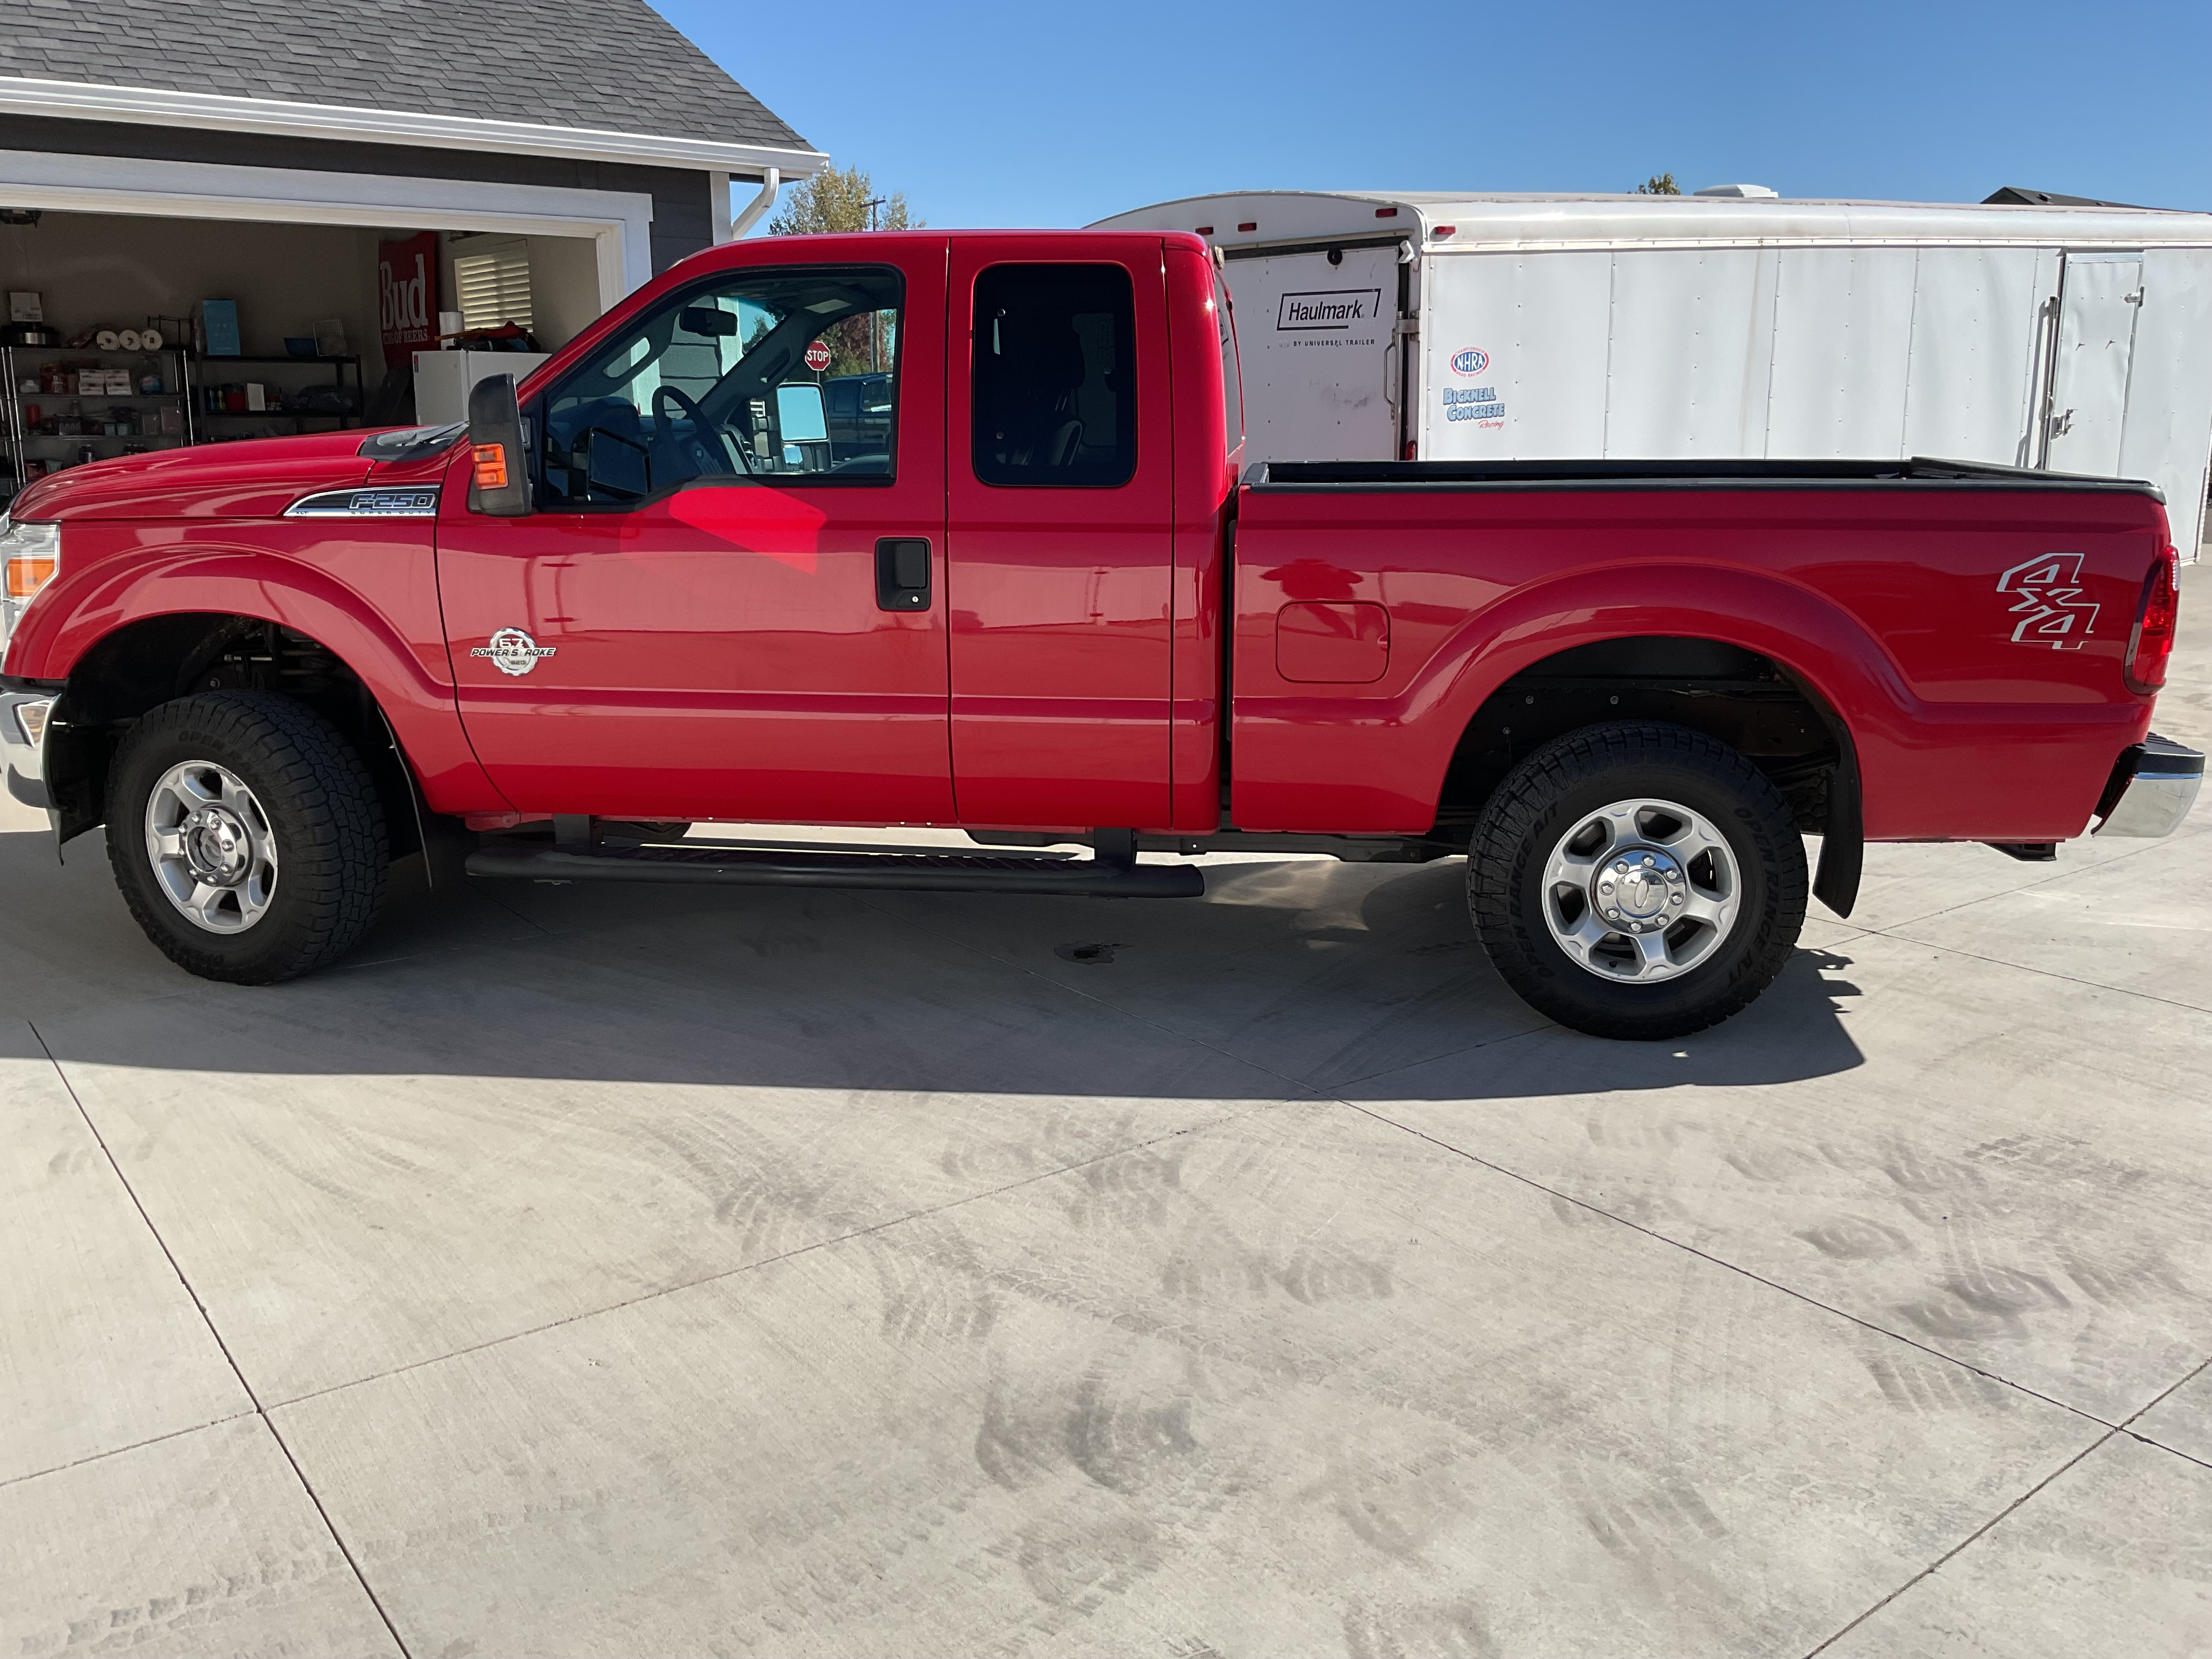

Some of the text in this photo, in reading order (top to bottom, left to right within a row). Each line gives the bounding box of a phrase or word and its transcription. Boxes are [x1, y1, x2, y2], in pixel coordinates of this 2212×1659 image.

[380, 253, 429, 330] Bud
[1289, 300, 1363, 320] Haulmark
[403, 328, 428, 343] BEERS
[807, 350, 828, 362] STOP
[1455, 347, 1485, 356] CHAMPIONSHIP
[1457, 353, 1483, 371] NHRA
[1468, 369, 1483, 377] RACING
[1443, 387, 1496, 405] BICKNELL
[1447, 403, 1505, 421] CONCRETE
[1479, 420, 1504, 430] Racing
[471, 648, 556, 657] POWERSROKE
[179, 730, 226, 751] OPEN
[1734, 807, 1776, 862] OPEN
[1509, 835, 1533, 919] RANGE
[1533, 800, 1558, 839] A/T
